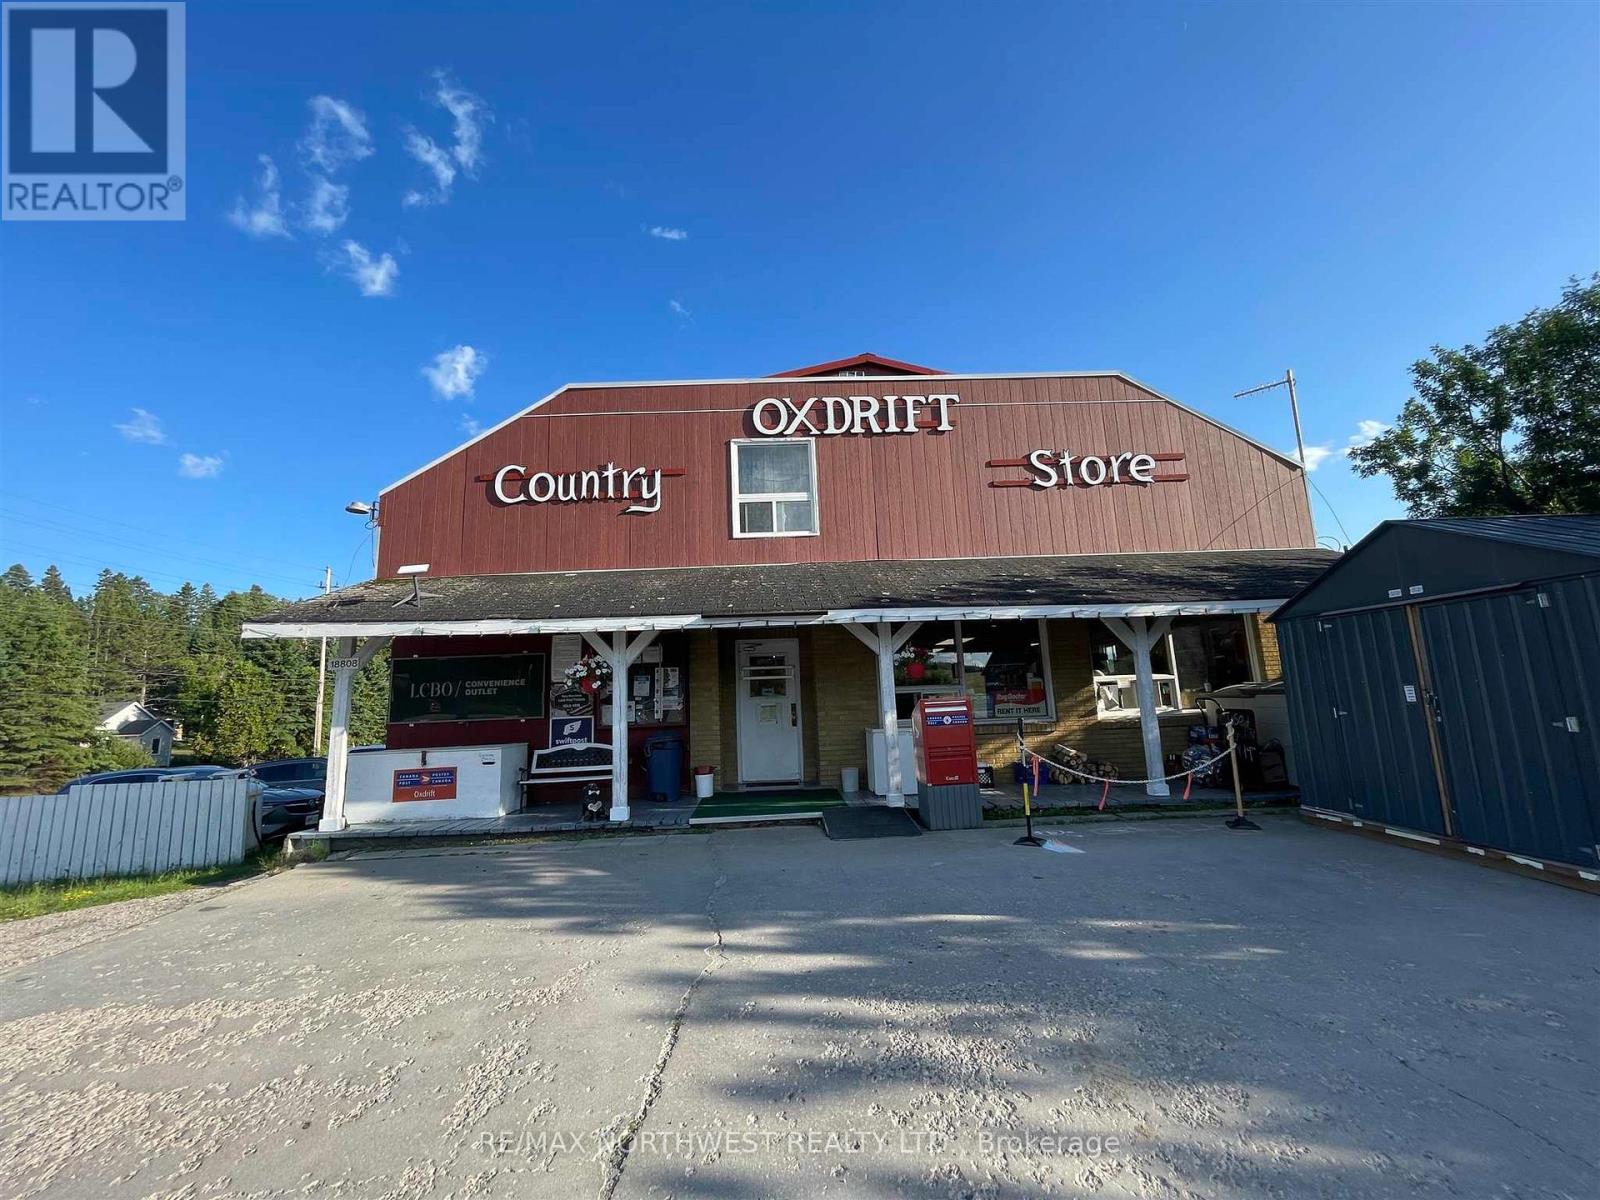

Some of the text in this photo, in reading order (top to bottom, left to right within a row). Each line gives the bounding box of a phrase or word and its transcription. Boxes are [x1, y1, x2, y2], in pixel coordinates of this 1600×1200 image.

[752, 394, 960, 435] OXDRIFT
[1030, 449, 1156, 487] Store
[494, 461, 662, 513] Country
[331, 659, 358, 668] 18808
[465, 679, 526, 688] CONVENIENCE
[410, 681, 453, 699] LCBO
[465, 688, 498, 696] OUTLET
[997, 707, 1014, 715] RENT
[1024, 706, 1041, 714] HERE
[556, 736, 588, 745] swiftpost
[413, 789, 436, 798] Oxdrift
